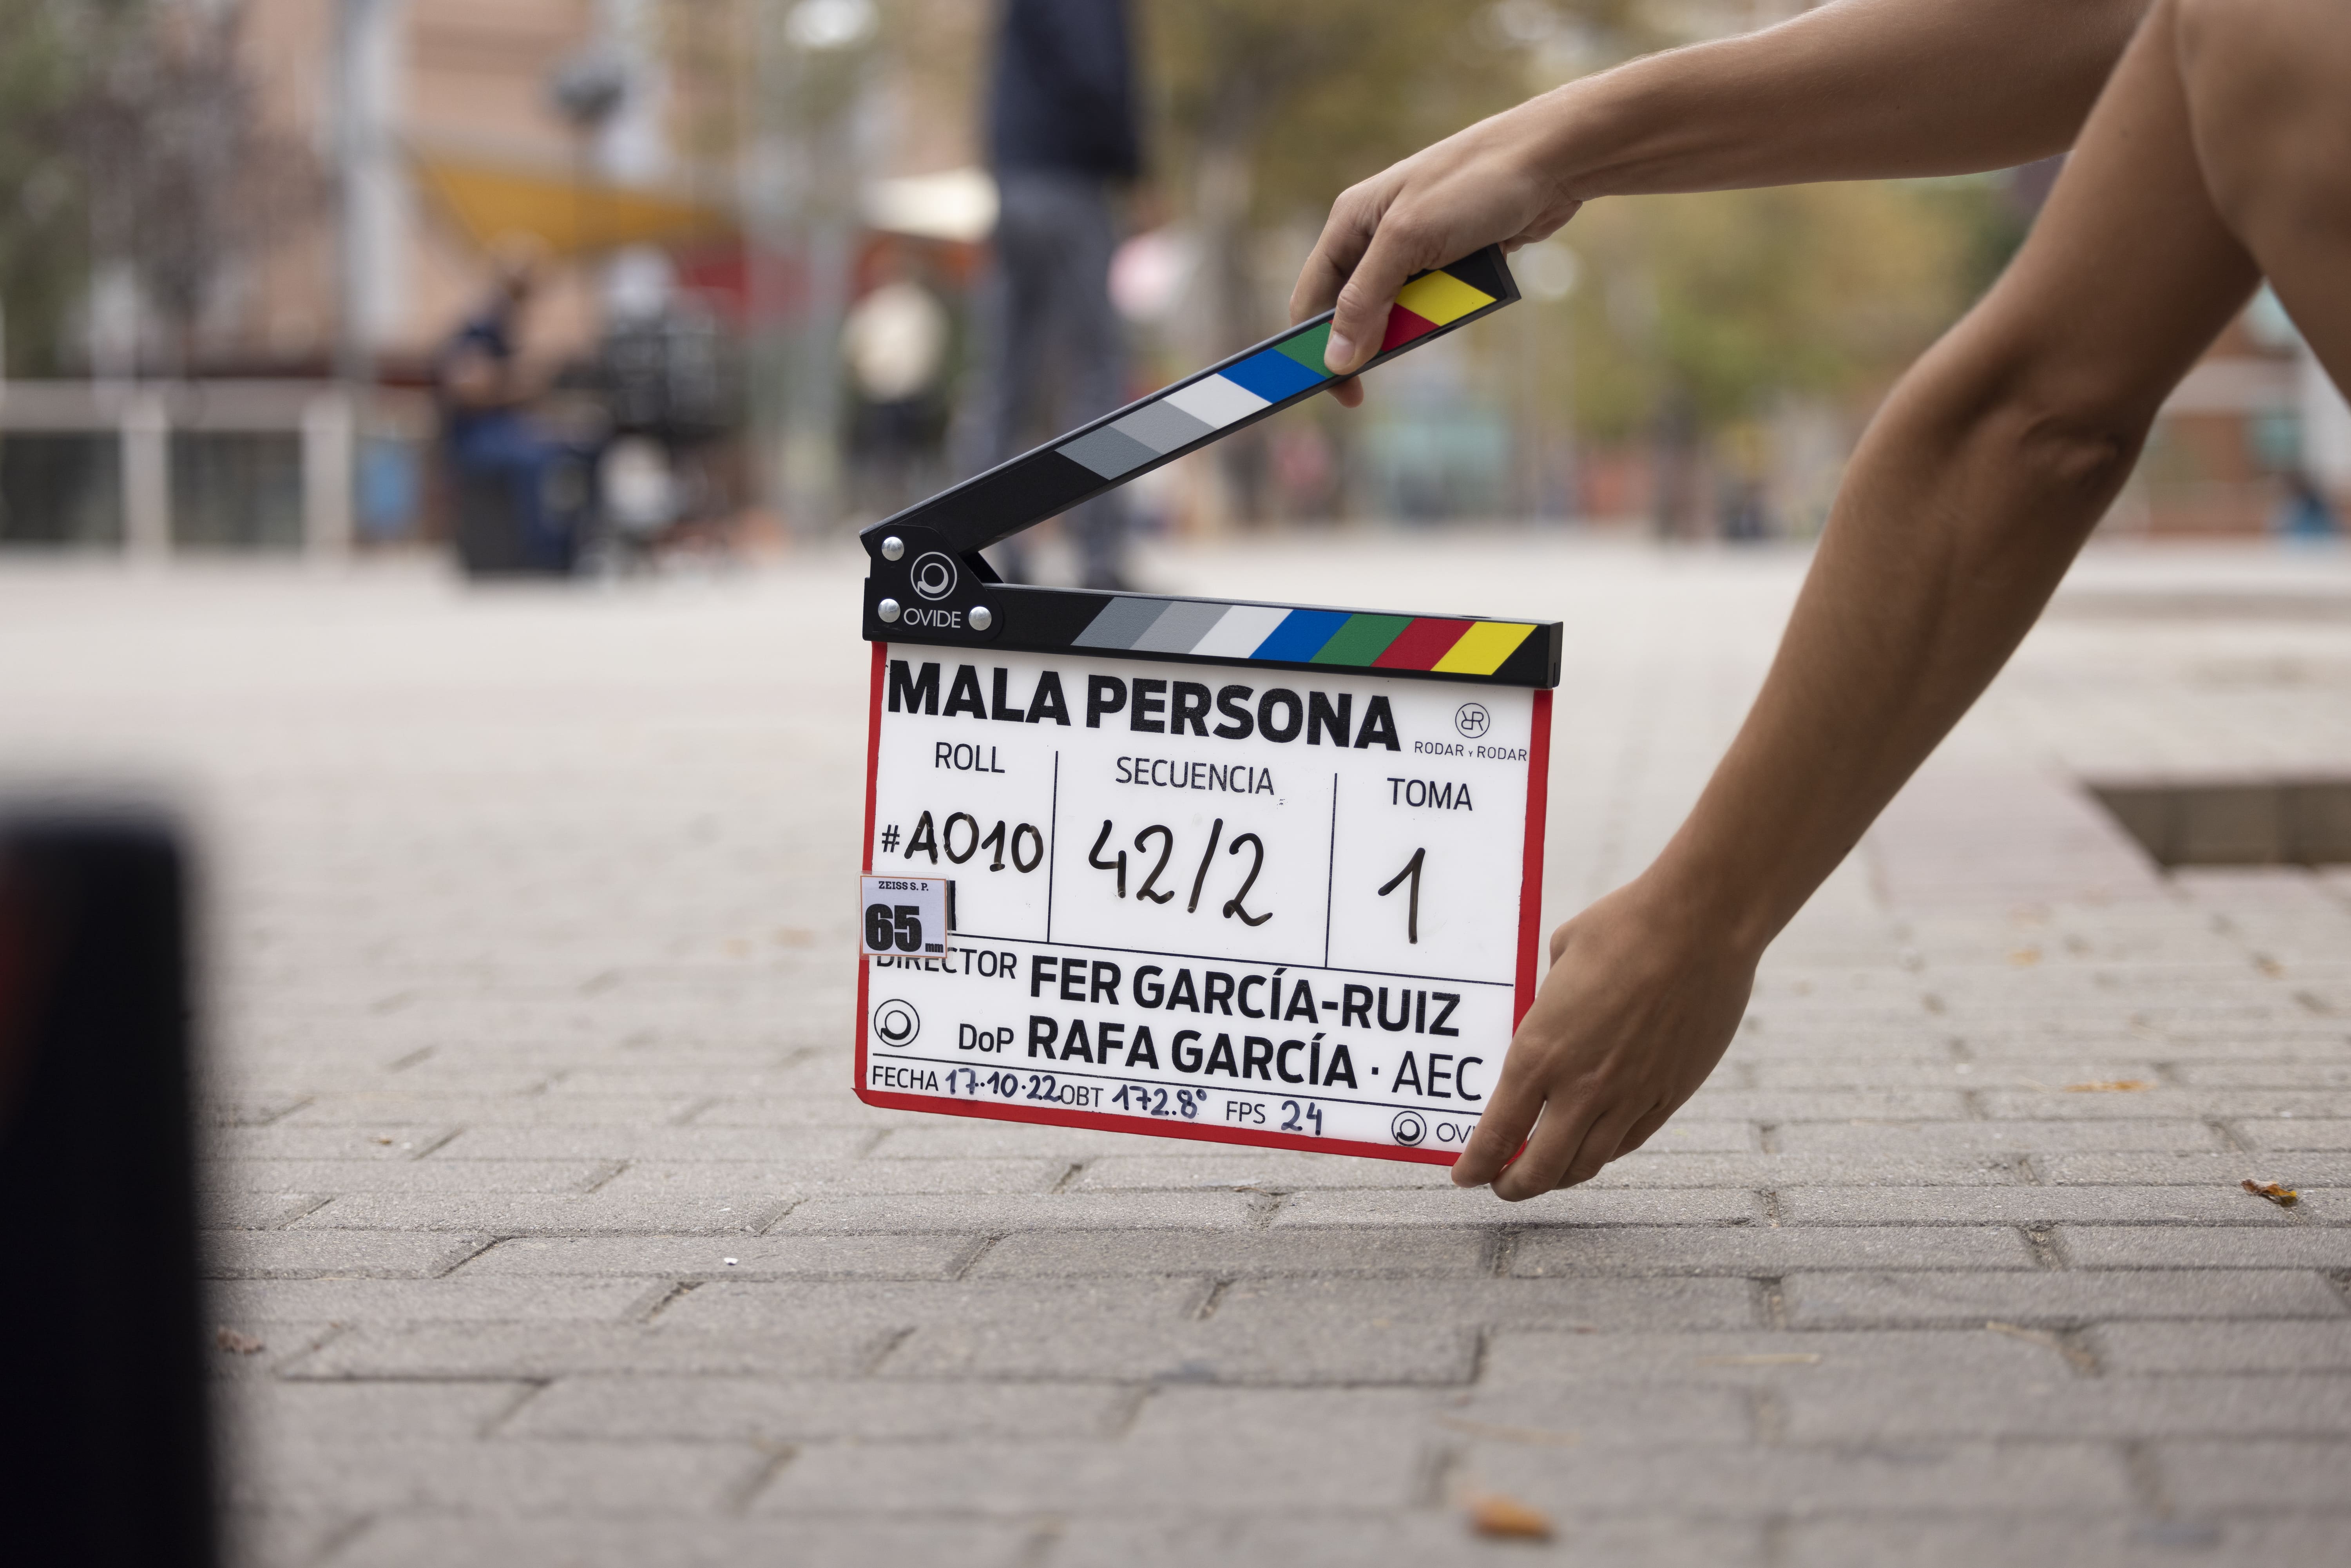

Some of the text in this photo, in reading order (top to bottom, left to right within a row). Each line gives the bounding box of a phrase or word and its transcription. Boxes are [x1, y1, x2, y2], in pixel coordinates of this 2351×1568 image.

[904, 608, 961, 628] OVIDE
[888, 659, 1402, 752] MALA PERSONA
[935, 741, 1005, 773] ROLL
[1415, 741, 1464, 757] RODAR
[1477, 746, 1527, 761] RODAR
[1115, 756, 1274, 797] SECUENCIA
[1387, 777, 1473, 811] TOMA
[878, 881, 909, 891] ZEISS
[1089, 818, 1273, 927] 42/2
[1377, 847, 1426, 944] 1
[865, 903, 944, 953] 65 mm
[1030, 954, 1121, 1005] FER
[1133, 965, 1461, 1037] GARCÍA-RUIZ
[958, 1023, 1014, 1054] DoP
[1028, 1014, 1159, 1070] RAFA
[1171, 1029, 1358, 1090] GARCÍA
[1391, 1050, 1484, 1101] AEC
[872, 1065, 939, 1092] FECHA
[1060, 1084, 1104, 1107] OBT
[1226, 1100, 1266, 1124] FPS
[1281, 1099, 1322, 1136] 24
